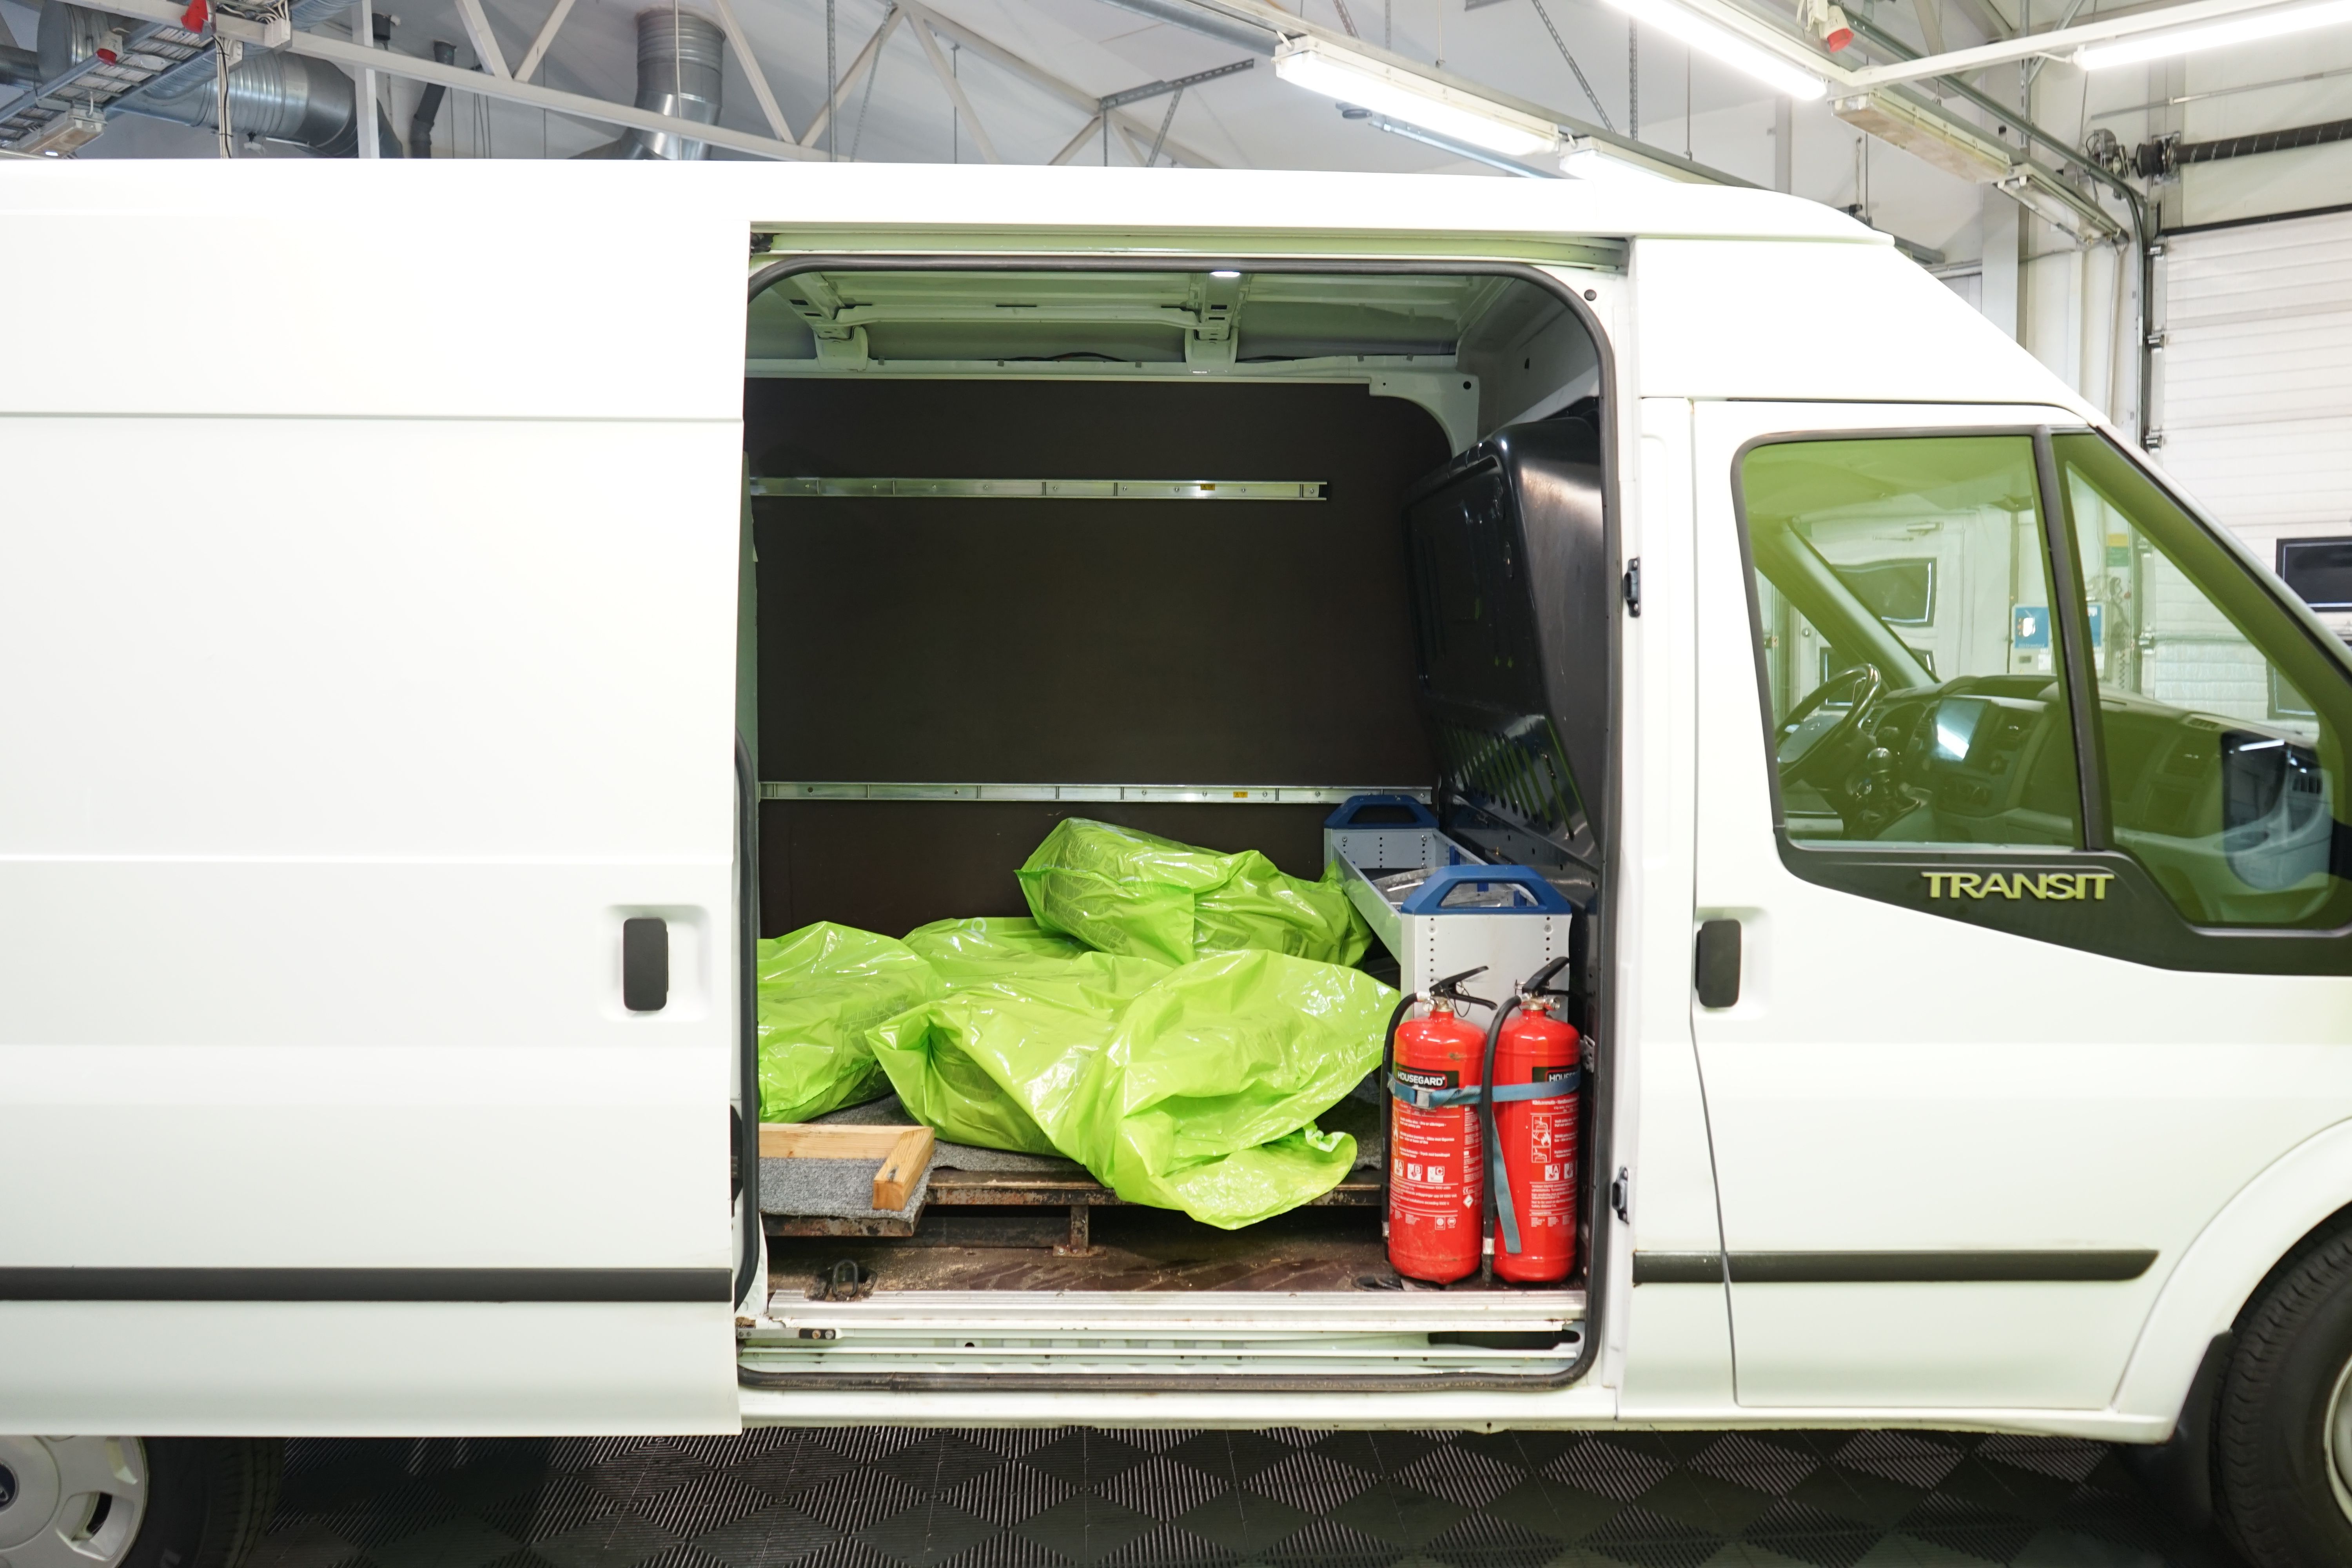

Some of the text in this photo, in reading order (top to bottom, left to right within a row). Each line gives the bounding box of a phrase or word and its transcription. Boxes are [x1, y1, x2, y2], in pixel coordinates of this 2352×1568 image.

[1922, 872, 2114, 900] TRANSIT
[1397, 1071, 1443, 1086] HOUSEGARD
[1399, 1161, 1403, 1170] A
[1415, 1165, 1421, 1174] B
[1553, 1165, 1559, 1173] A
